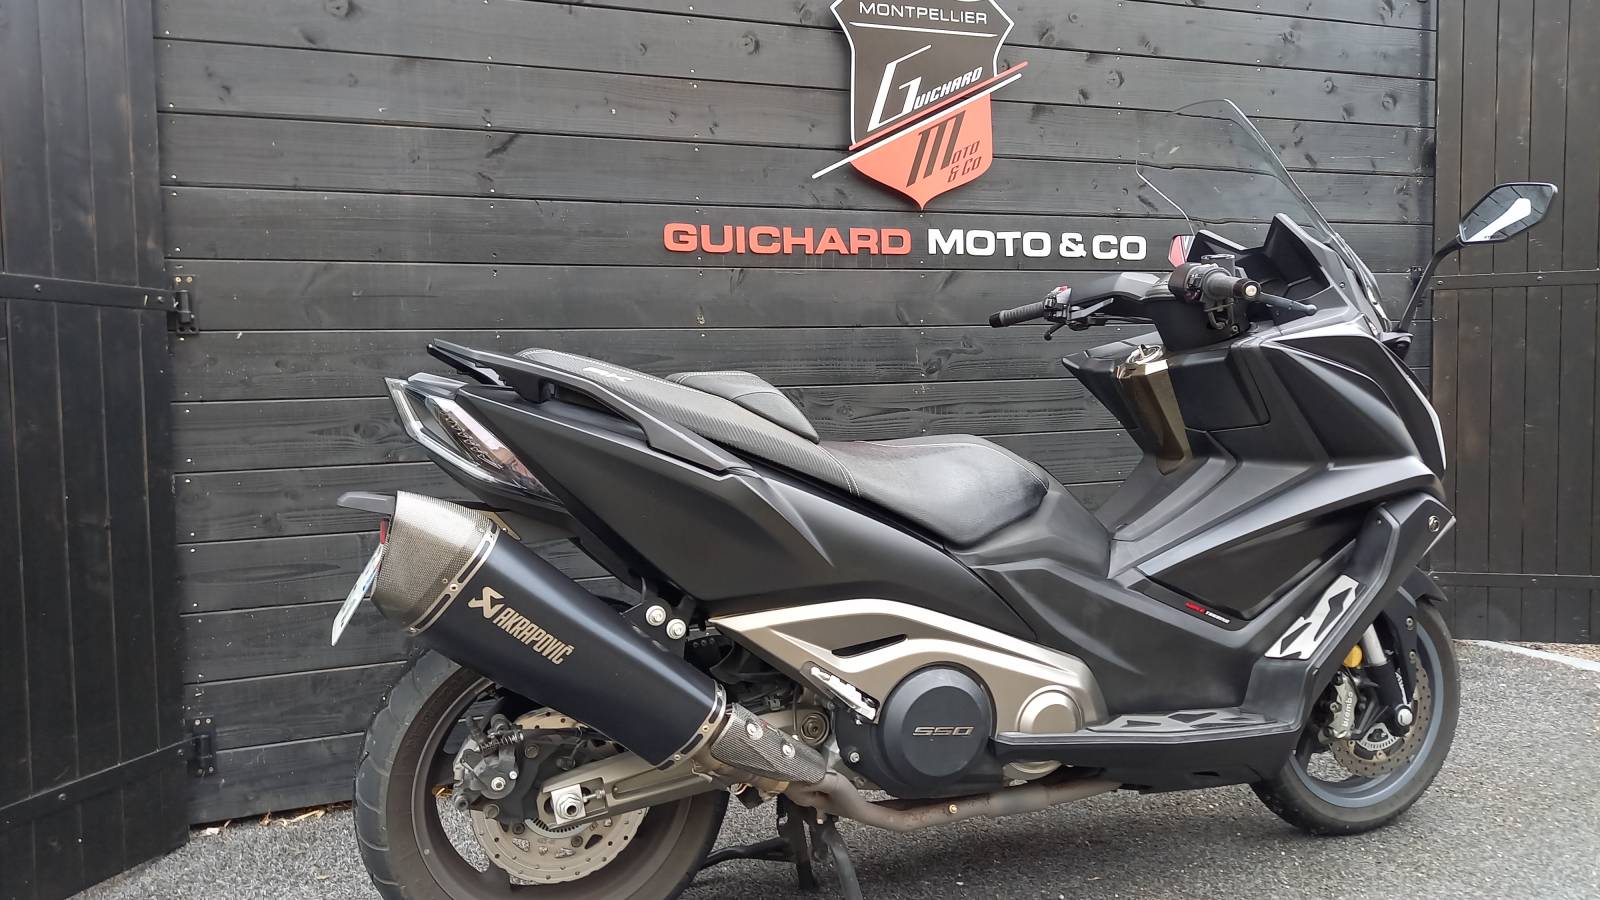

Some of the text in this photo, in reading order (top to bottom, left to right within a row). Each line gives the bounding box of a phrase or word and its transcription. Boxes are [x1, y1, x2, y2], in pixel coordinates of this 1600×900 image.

[859, 1, 988, 25] MONTPELLIER
[663, 222, 1147, 261] GUICHARD MOTO & CO
